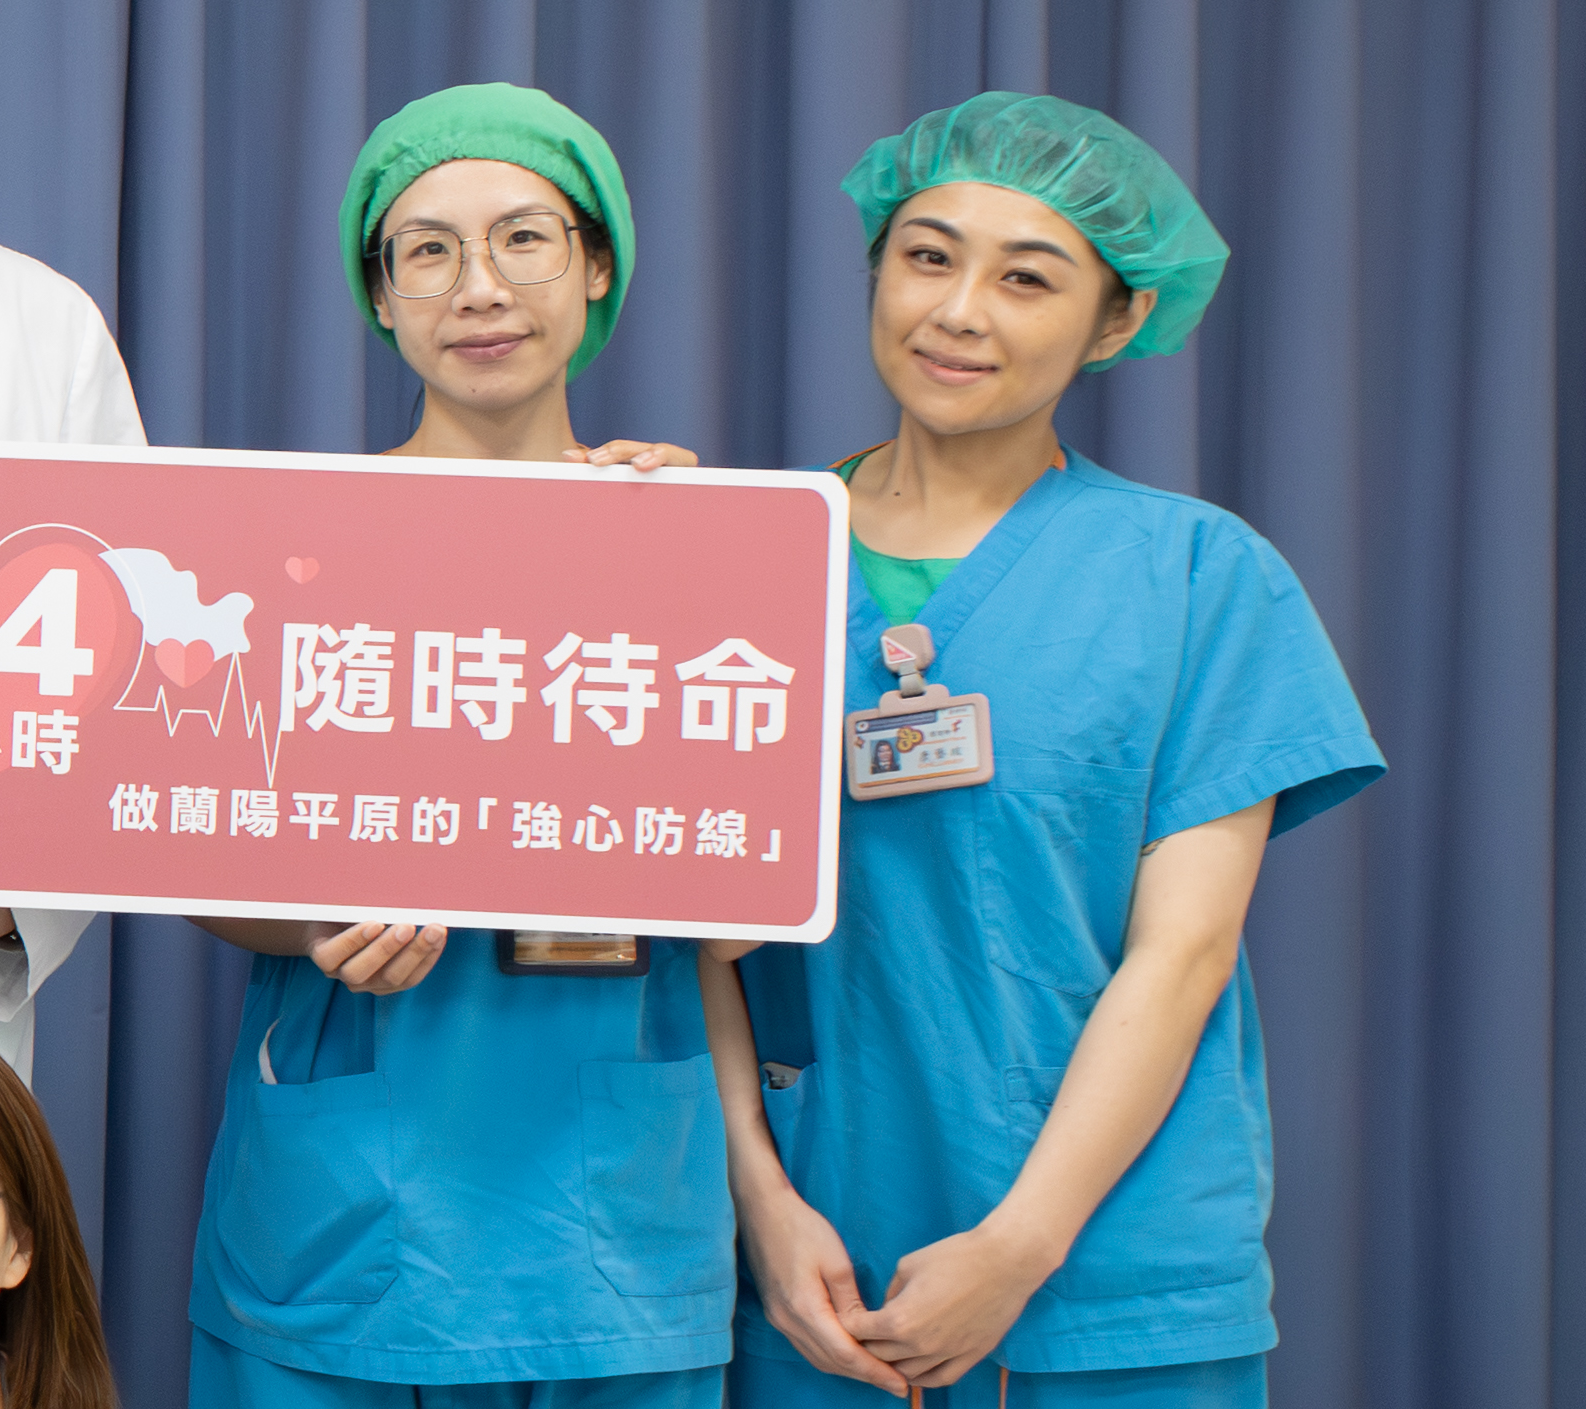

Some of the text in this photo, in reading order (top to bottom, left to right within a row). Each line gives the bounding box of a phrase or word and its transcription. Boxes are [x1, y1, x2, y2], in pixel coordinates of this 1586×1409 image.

[279, 621, 796, 753] 隨時待命
[107, 781, 784, 865] 做蘭陽平原的「強心防線」
